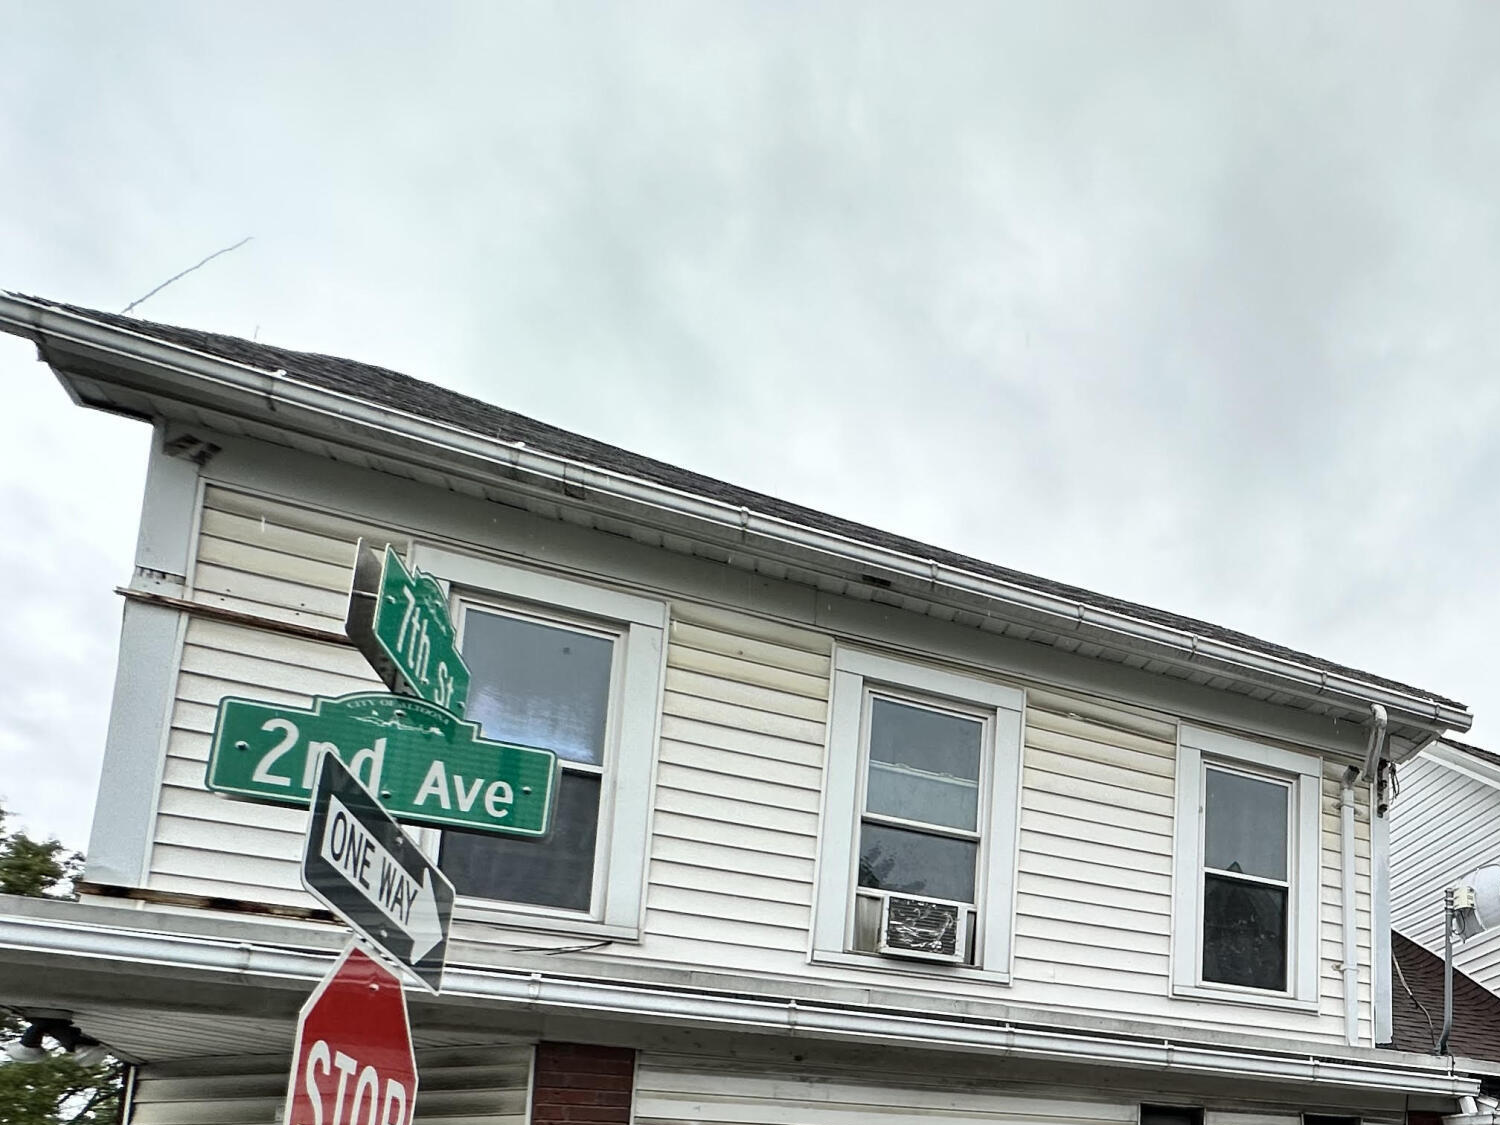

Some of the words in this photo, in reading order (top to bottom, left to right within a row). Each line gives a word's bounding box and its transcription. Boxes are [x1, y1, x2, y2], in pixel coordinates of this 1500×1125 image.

[397, 585, 430, 680] 7th
[434, 661, 454, 709] St
[346, 700, 375, 709] CITY
[252, 718, 387, 799] 2nd
[413, 760, 514, 818] Ave
[330, 811, 377, 891] ONE
[378, 856, 423, 927] WAY
